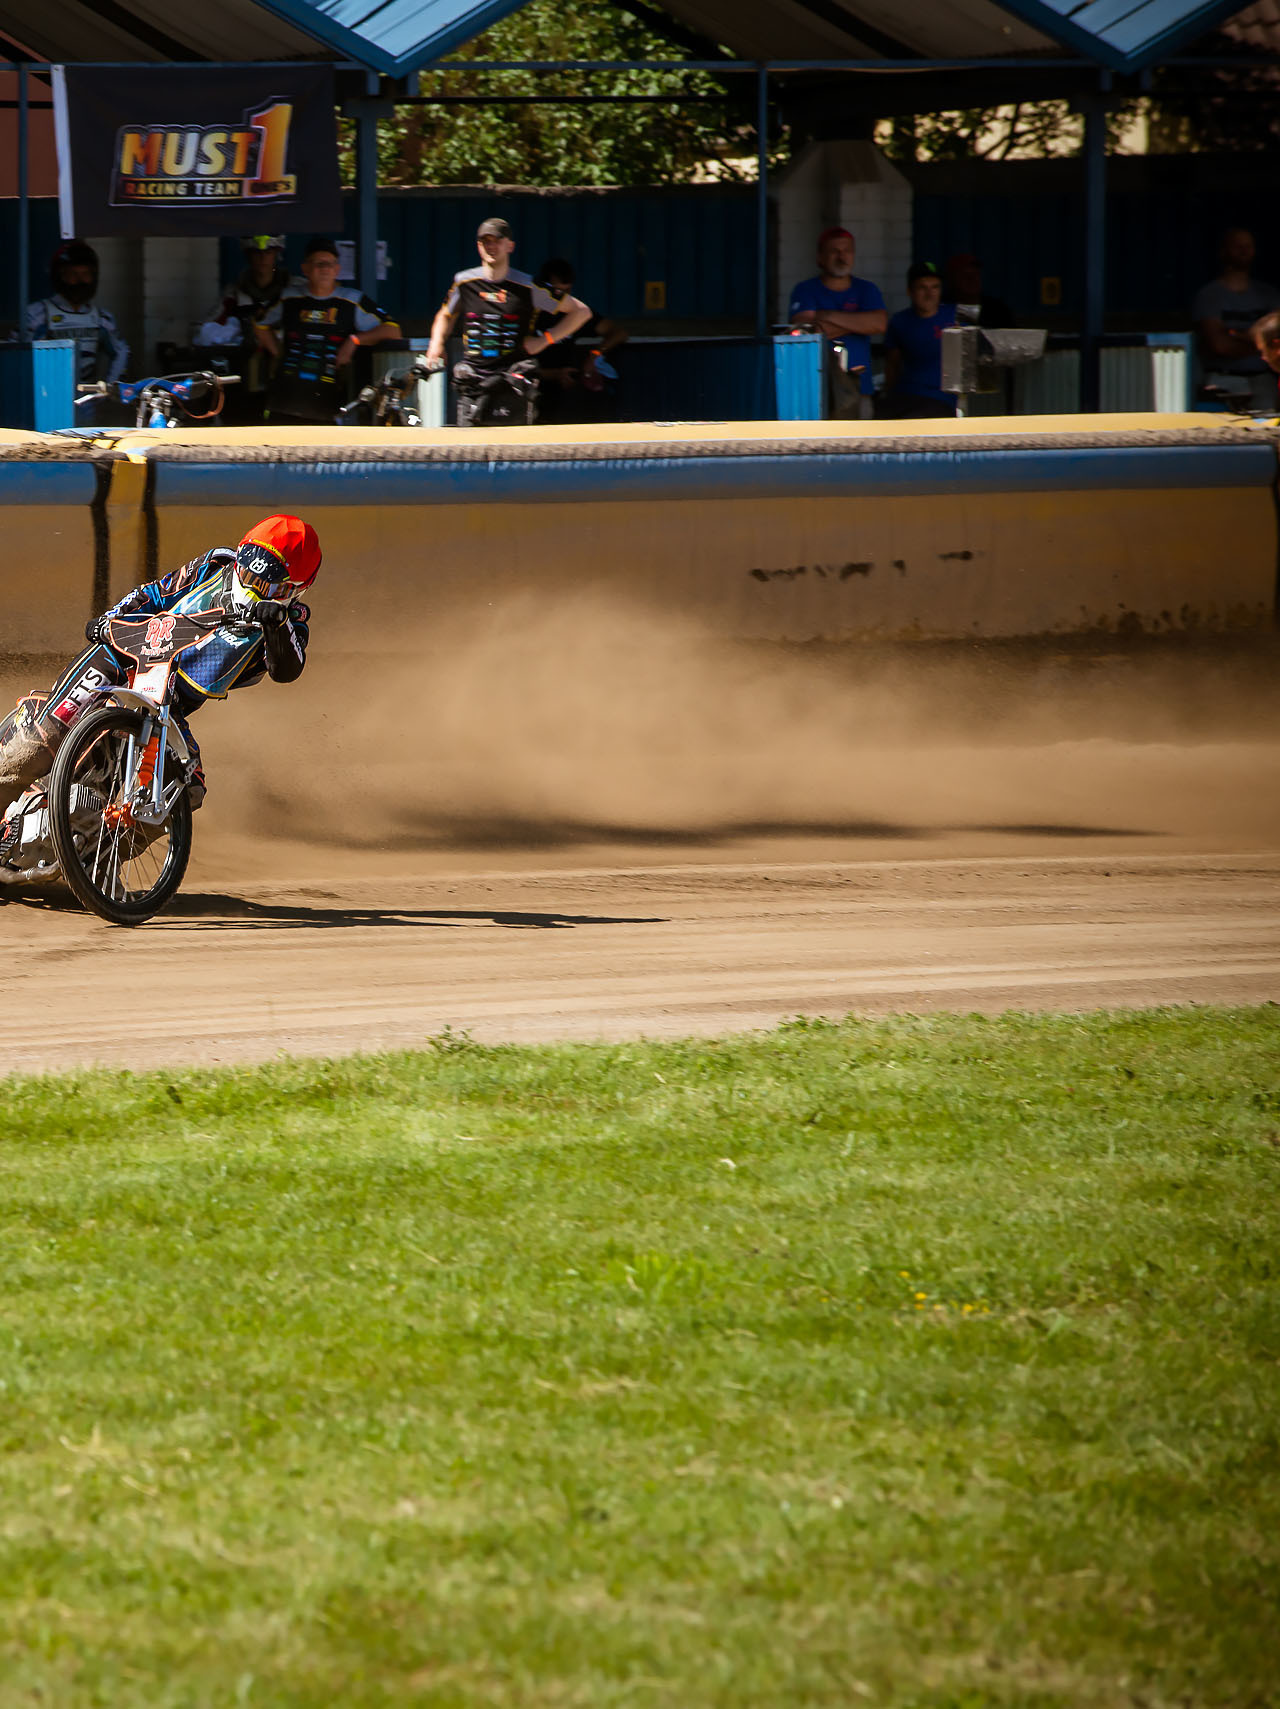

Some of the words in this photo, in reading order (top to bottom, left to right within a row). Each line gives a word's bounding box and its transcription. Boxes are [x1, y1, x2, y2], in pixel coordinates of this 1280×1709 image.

[121, 132, 256, 176] MUST
[250, 103, 296, 197] 1
[124, 182, 188, 195] RACING
[194, 182, 240, 195] TEAM
[68, 669, 103, 707] FTS
